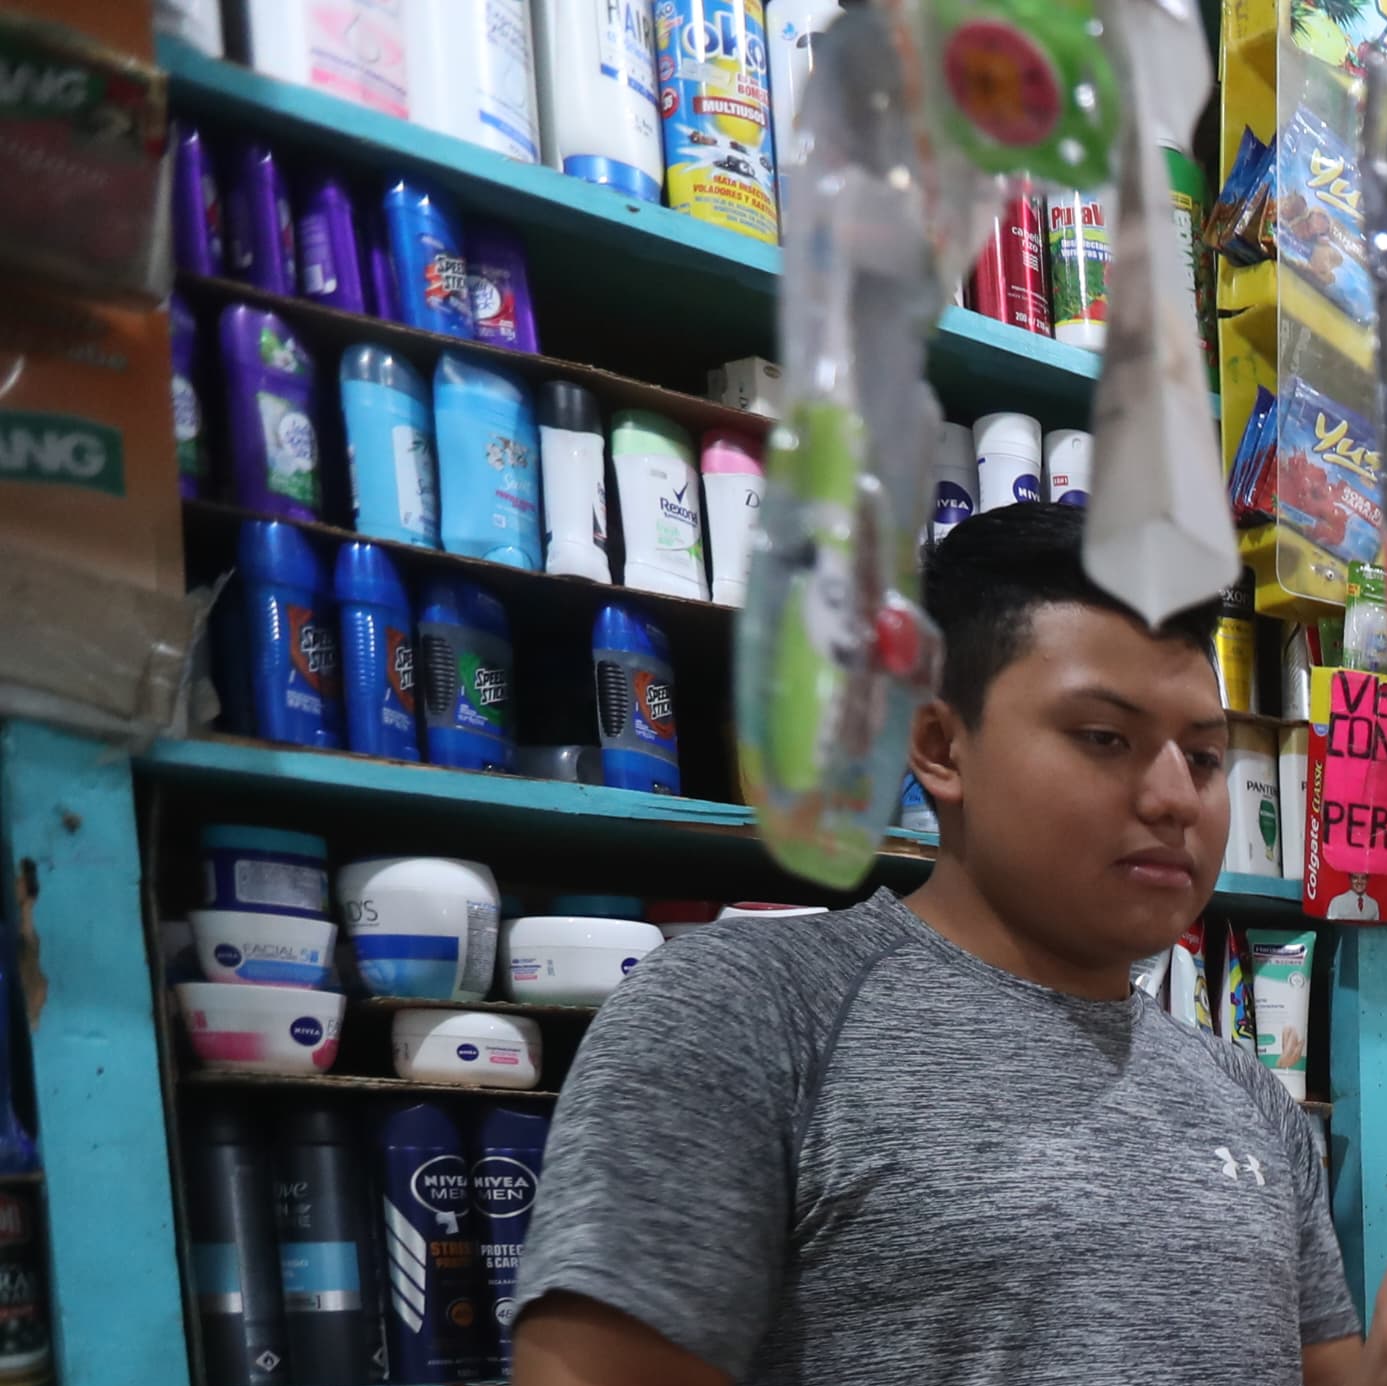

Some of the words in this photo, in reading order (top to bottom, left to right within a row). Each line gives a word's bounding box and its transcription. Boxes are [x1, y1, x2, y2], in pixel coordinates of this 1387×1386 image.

[658, 497, 700, 524] Rexona
[934, 498, 971, 511] IVEA
[1306, 816, 1321, 900] Colgate
[292, 1024, 322, 1037] NIVEA
[473, 1174, 531, 1192] NIVEA
[477, 1186, 525, 1202] MEN
[480, 1243, 524, 1259] PROTEC
[495, 1255, 523, 1269] CAR
